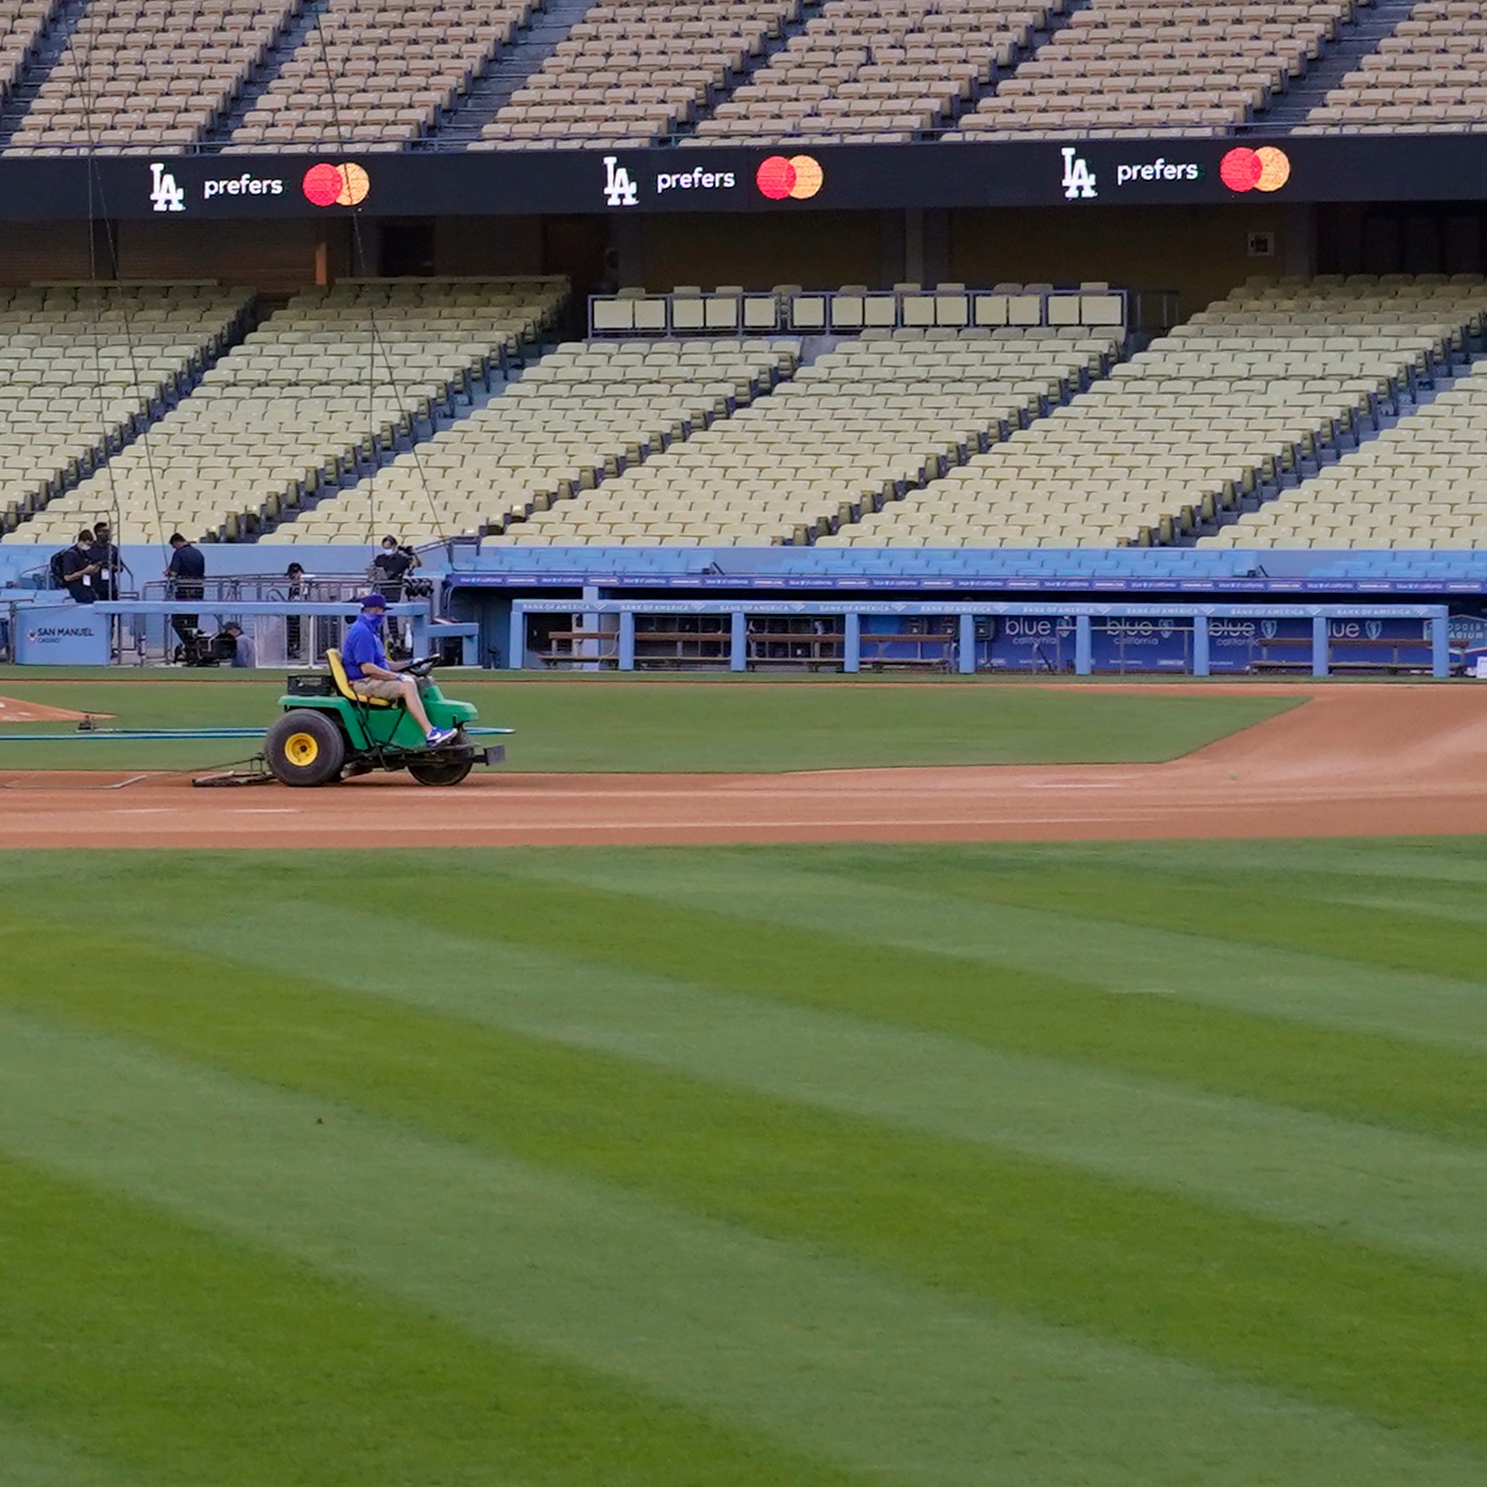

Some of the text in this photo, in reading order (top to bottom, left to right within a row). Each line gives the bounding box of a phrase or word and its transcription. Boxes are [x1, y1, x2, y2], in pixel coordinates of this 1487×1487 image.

[604, 156, 735, 206] LA prefers
[1062, 148, 1198, 198] LA prefers
[150, 163, 283, 212] LA prefers
[38, 627, 94, 637] SAN MANUEL
[1006, 617, 1052, 636] blue
[1107, 618, 1154, 636] blue
[1208, 619, 1255, 637] blue
[1326, 619, 1360, 638] lue
[1013, 636, 1057, 646] california
[1113, 637, 1159, 646] california
